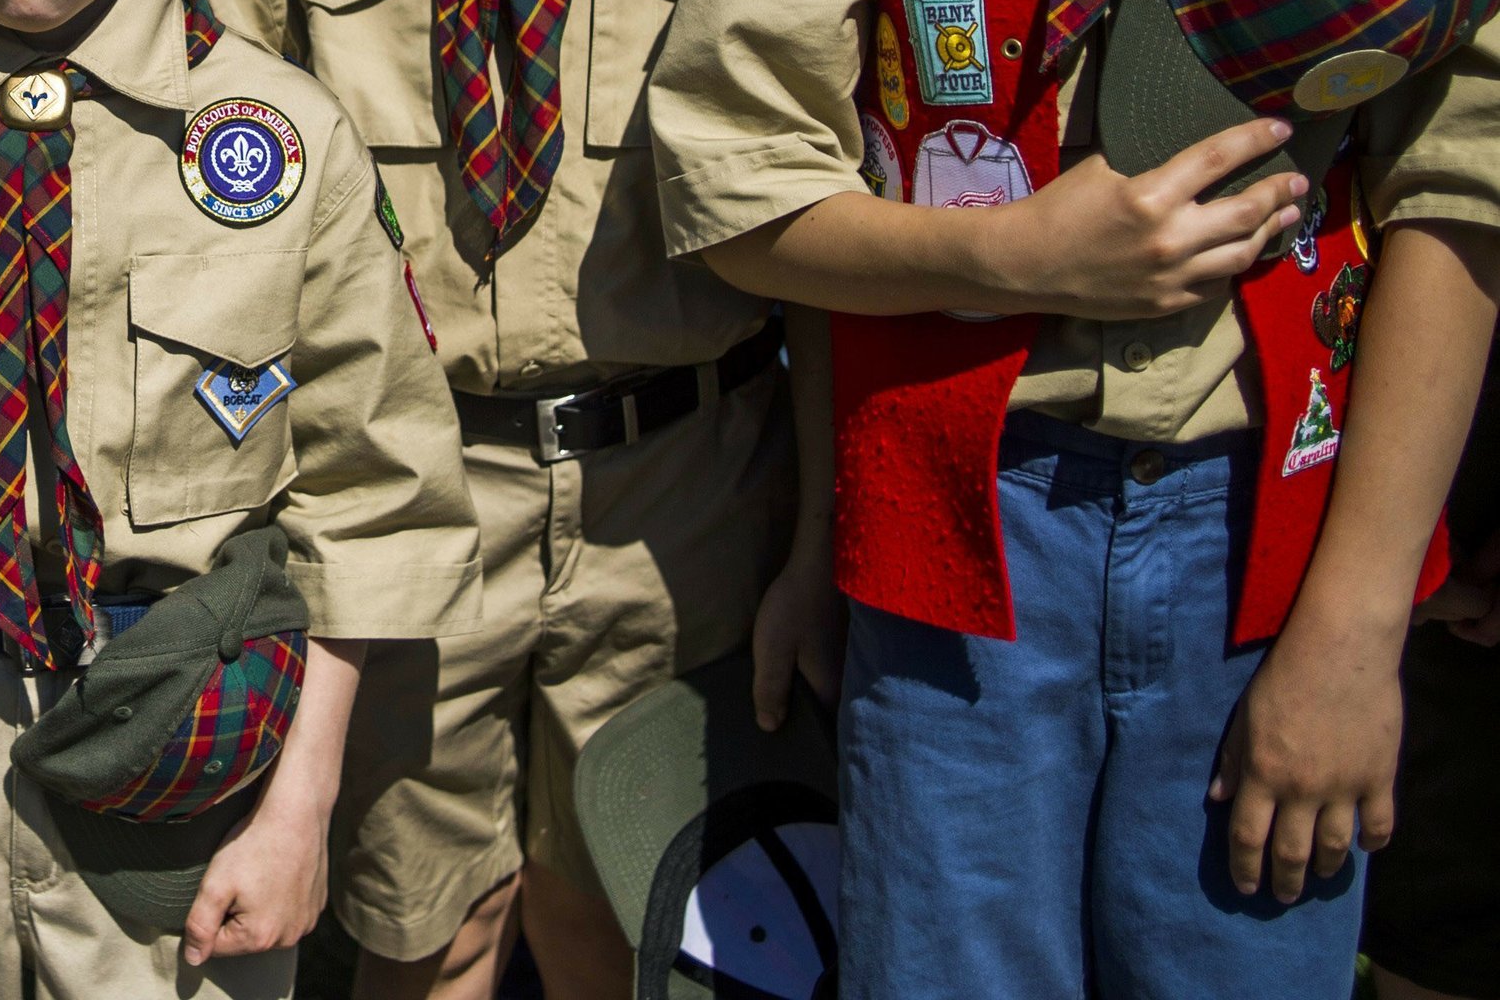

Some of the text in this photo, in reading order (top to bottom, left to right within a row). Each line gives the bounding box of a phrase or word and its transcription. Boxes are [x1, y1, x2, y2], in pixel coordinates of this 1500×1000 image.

[926, 4, 976, 23] BANK
[937, 73, 986, 91] TOUR
[186, 103, 298, 155] BOY SCOUTS OF AMERICA
[212, 199, 275, 218] SINCE 1910
[223, 394, 263, 407] BOBCAT
